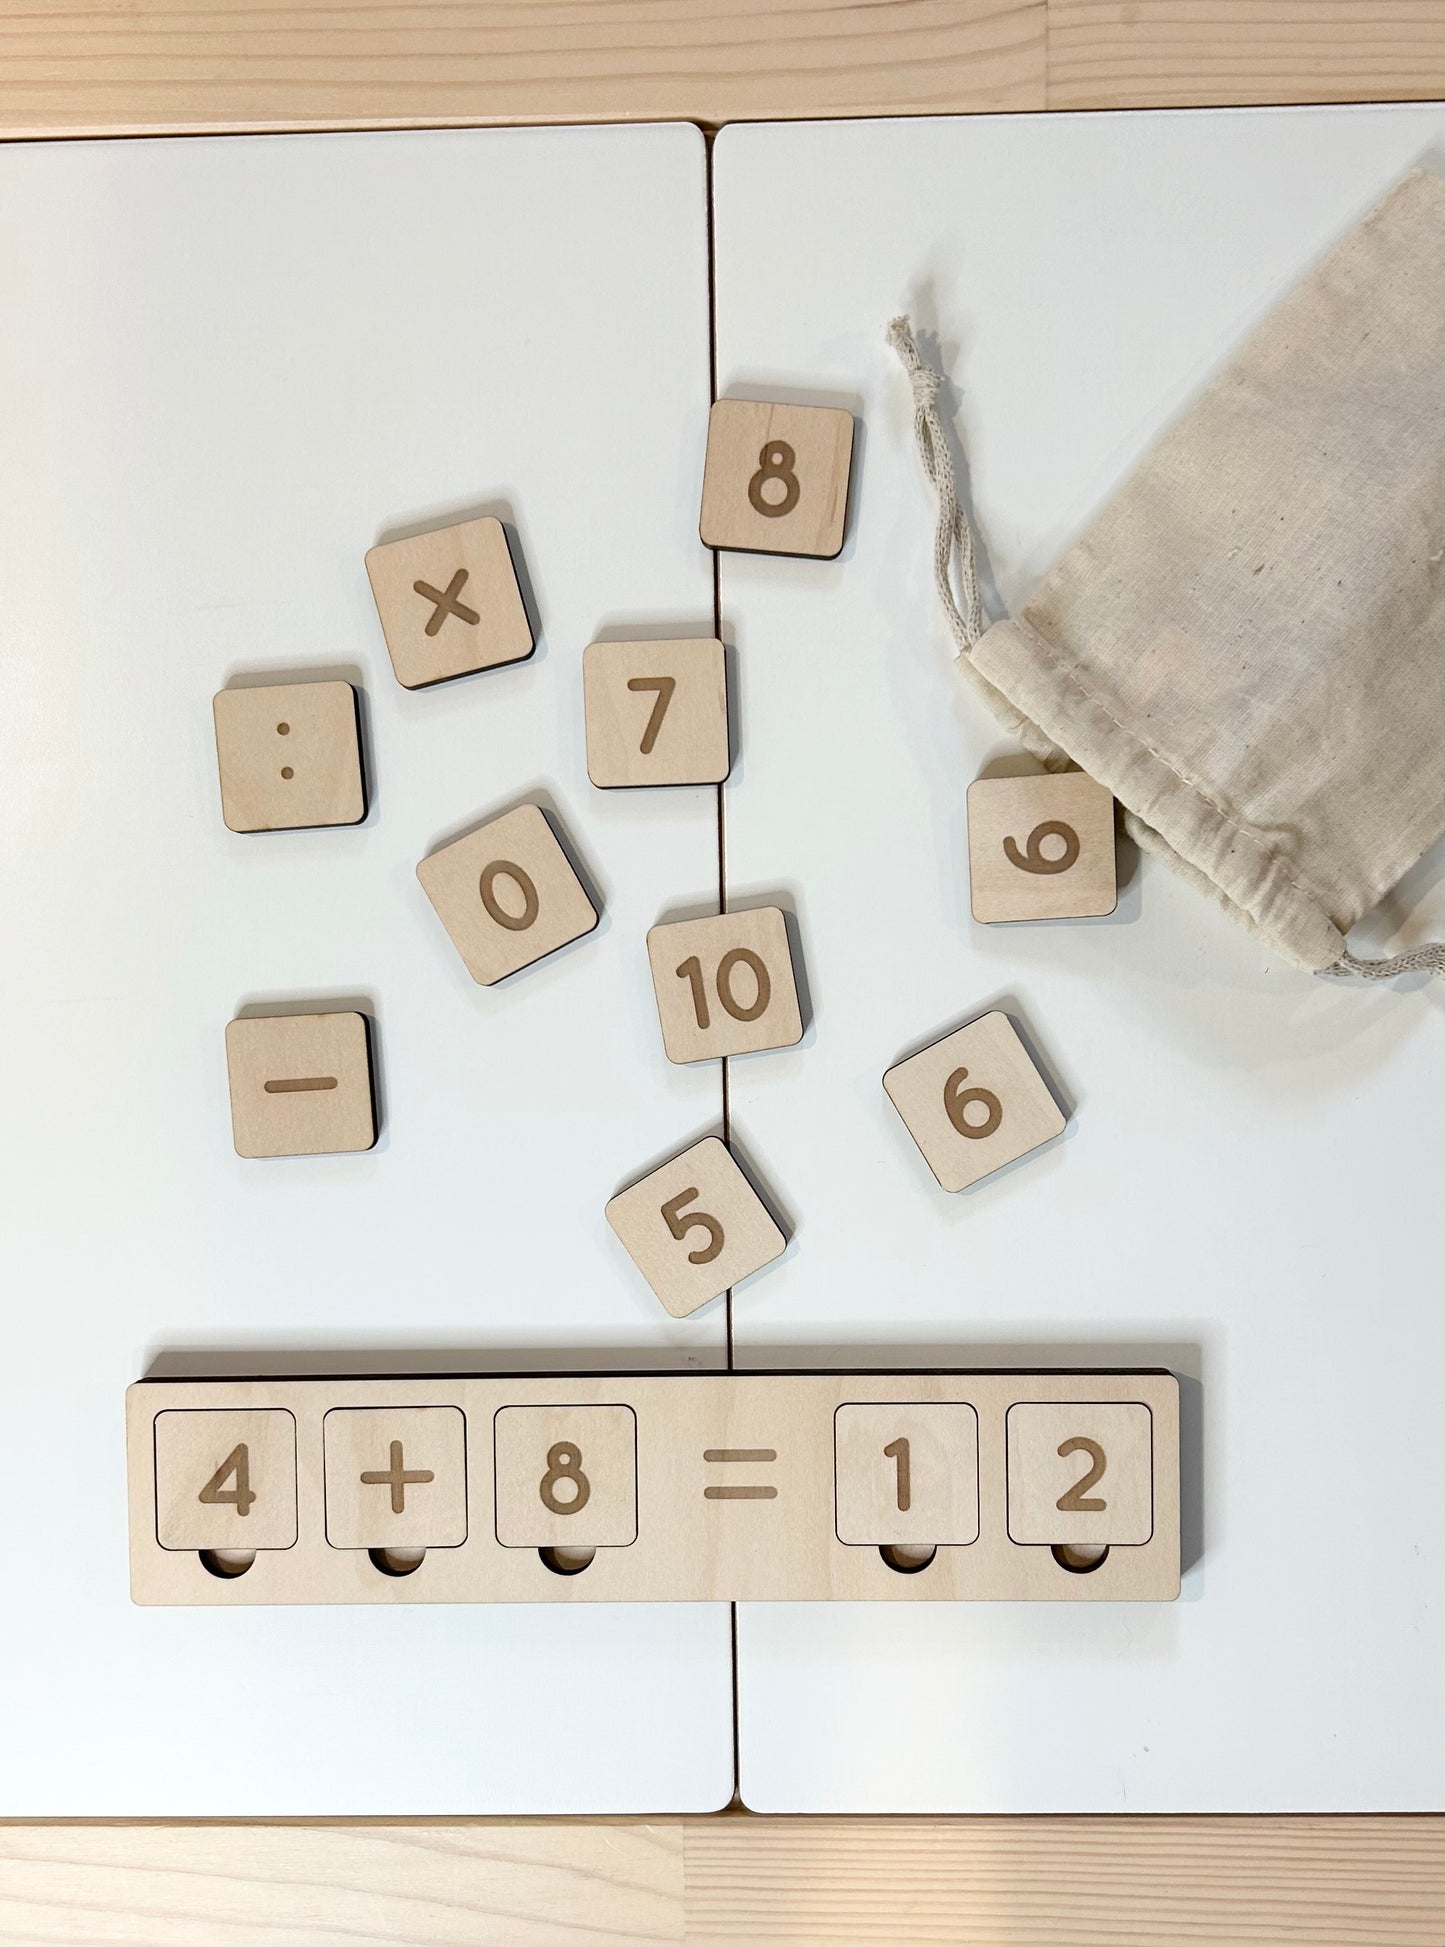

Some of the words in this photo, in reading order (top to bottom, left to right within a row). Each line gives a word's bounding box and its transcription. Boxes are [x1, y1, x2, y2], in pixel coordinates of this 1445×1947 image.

[748, 440, 801, 519] 8
[627, 677, 676, 754] 7
[479, 860, 540, 931] 0
[676, 948, 771, 1029] 10
[944, 1067, 1003, 1139] 6
[661, 1187, 725, 1265] 5
[198, 1443, 257, 1516] 4
[360, 1440, 434, 1514] +
[539, 1441, 590, 1515] 8
[703, 1449, 778, 1500] =
[884, 1437, 911, 1512] 1
[1056, 1437, 1107, 1511] 2
